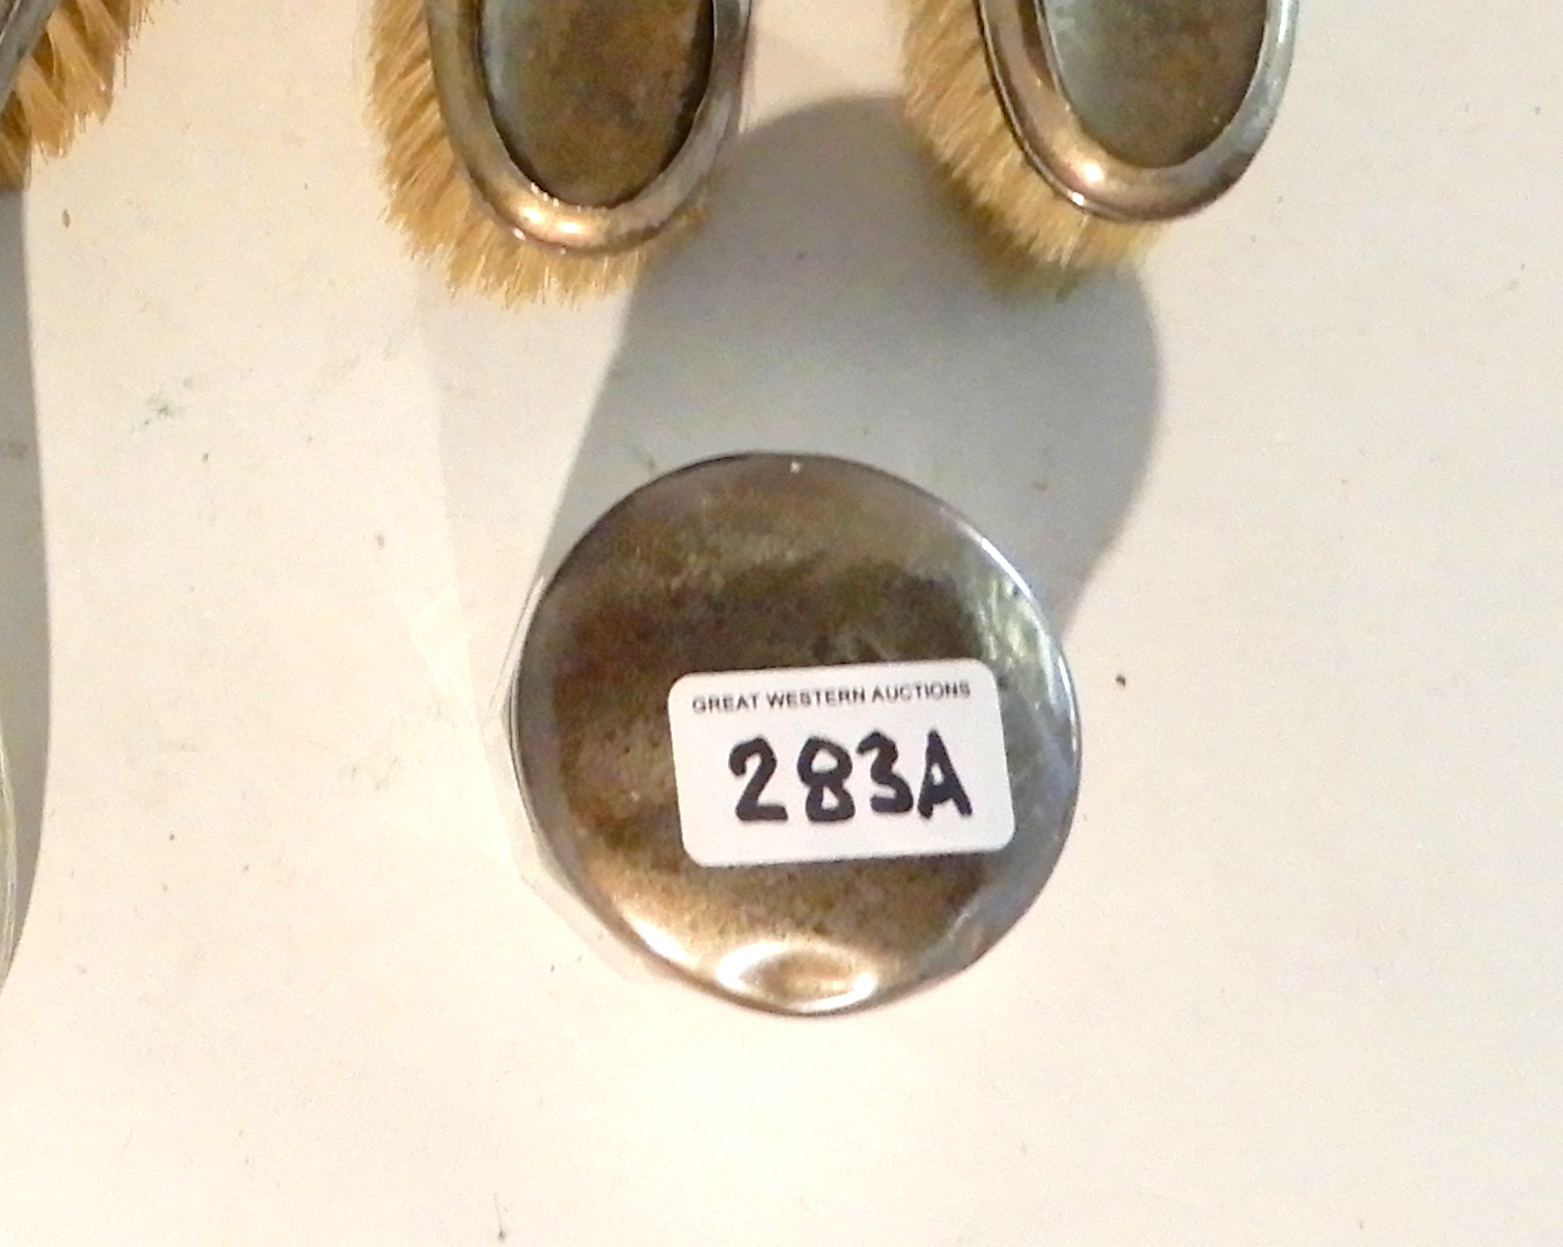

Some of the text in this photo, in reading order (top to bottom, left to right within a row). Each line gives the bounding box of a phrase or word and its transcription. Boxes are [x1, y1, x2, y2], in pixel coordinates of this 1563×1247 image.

[692, 681, 971, 714] GREAT WESTERN AUCTIONS
[728, 729, 973, 822] 283A
